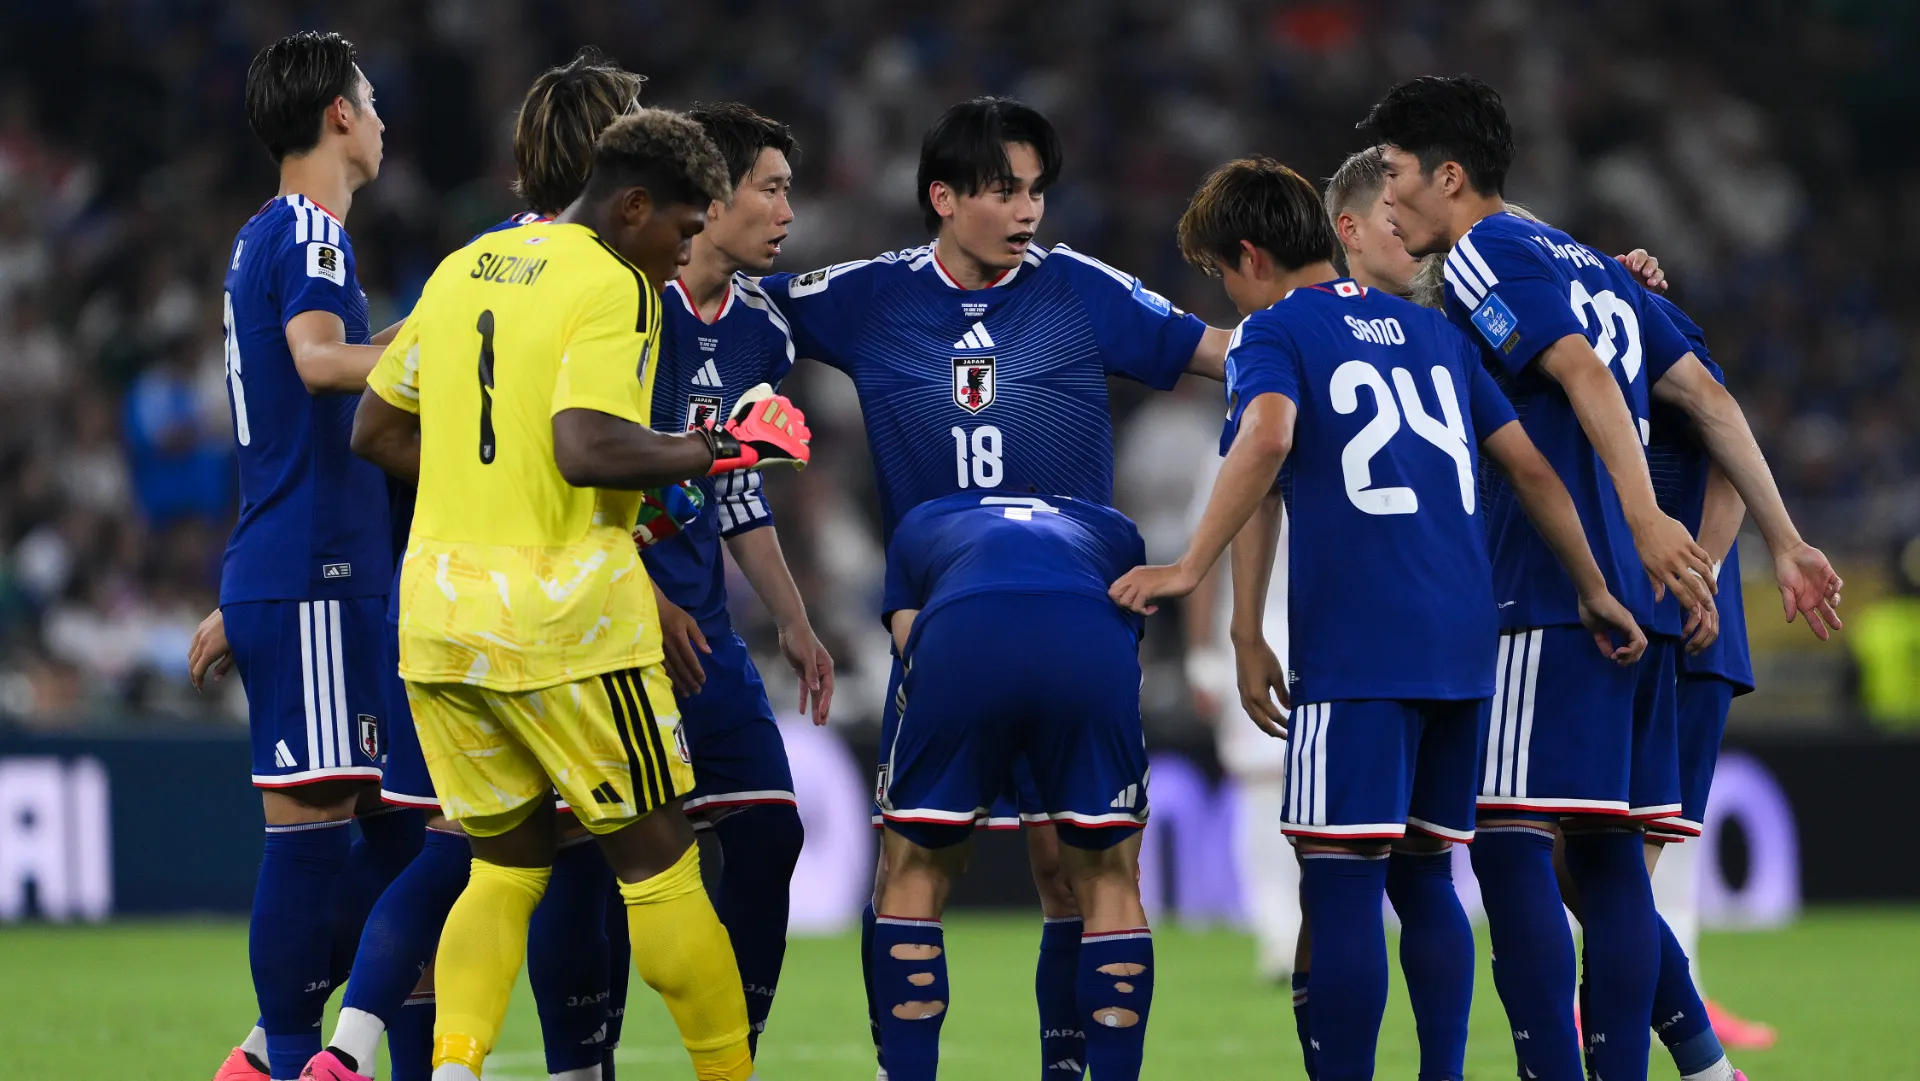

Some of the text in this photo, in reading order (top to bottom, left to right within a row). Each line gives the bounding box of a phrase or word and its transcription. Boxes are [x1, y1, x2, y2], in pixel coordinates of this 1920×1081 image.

[470, 253, 548, 286] SUZUKI
[1344, 315, 1406, 346] SANO
[476, 308, 496, 465] 1
[951, 425, 1004, 489] 18
[1329, 360, 1475, 515] 24
